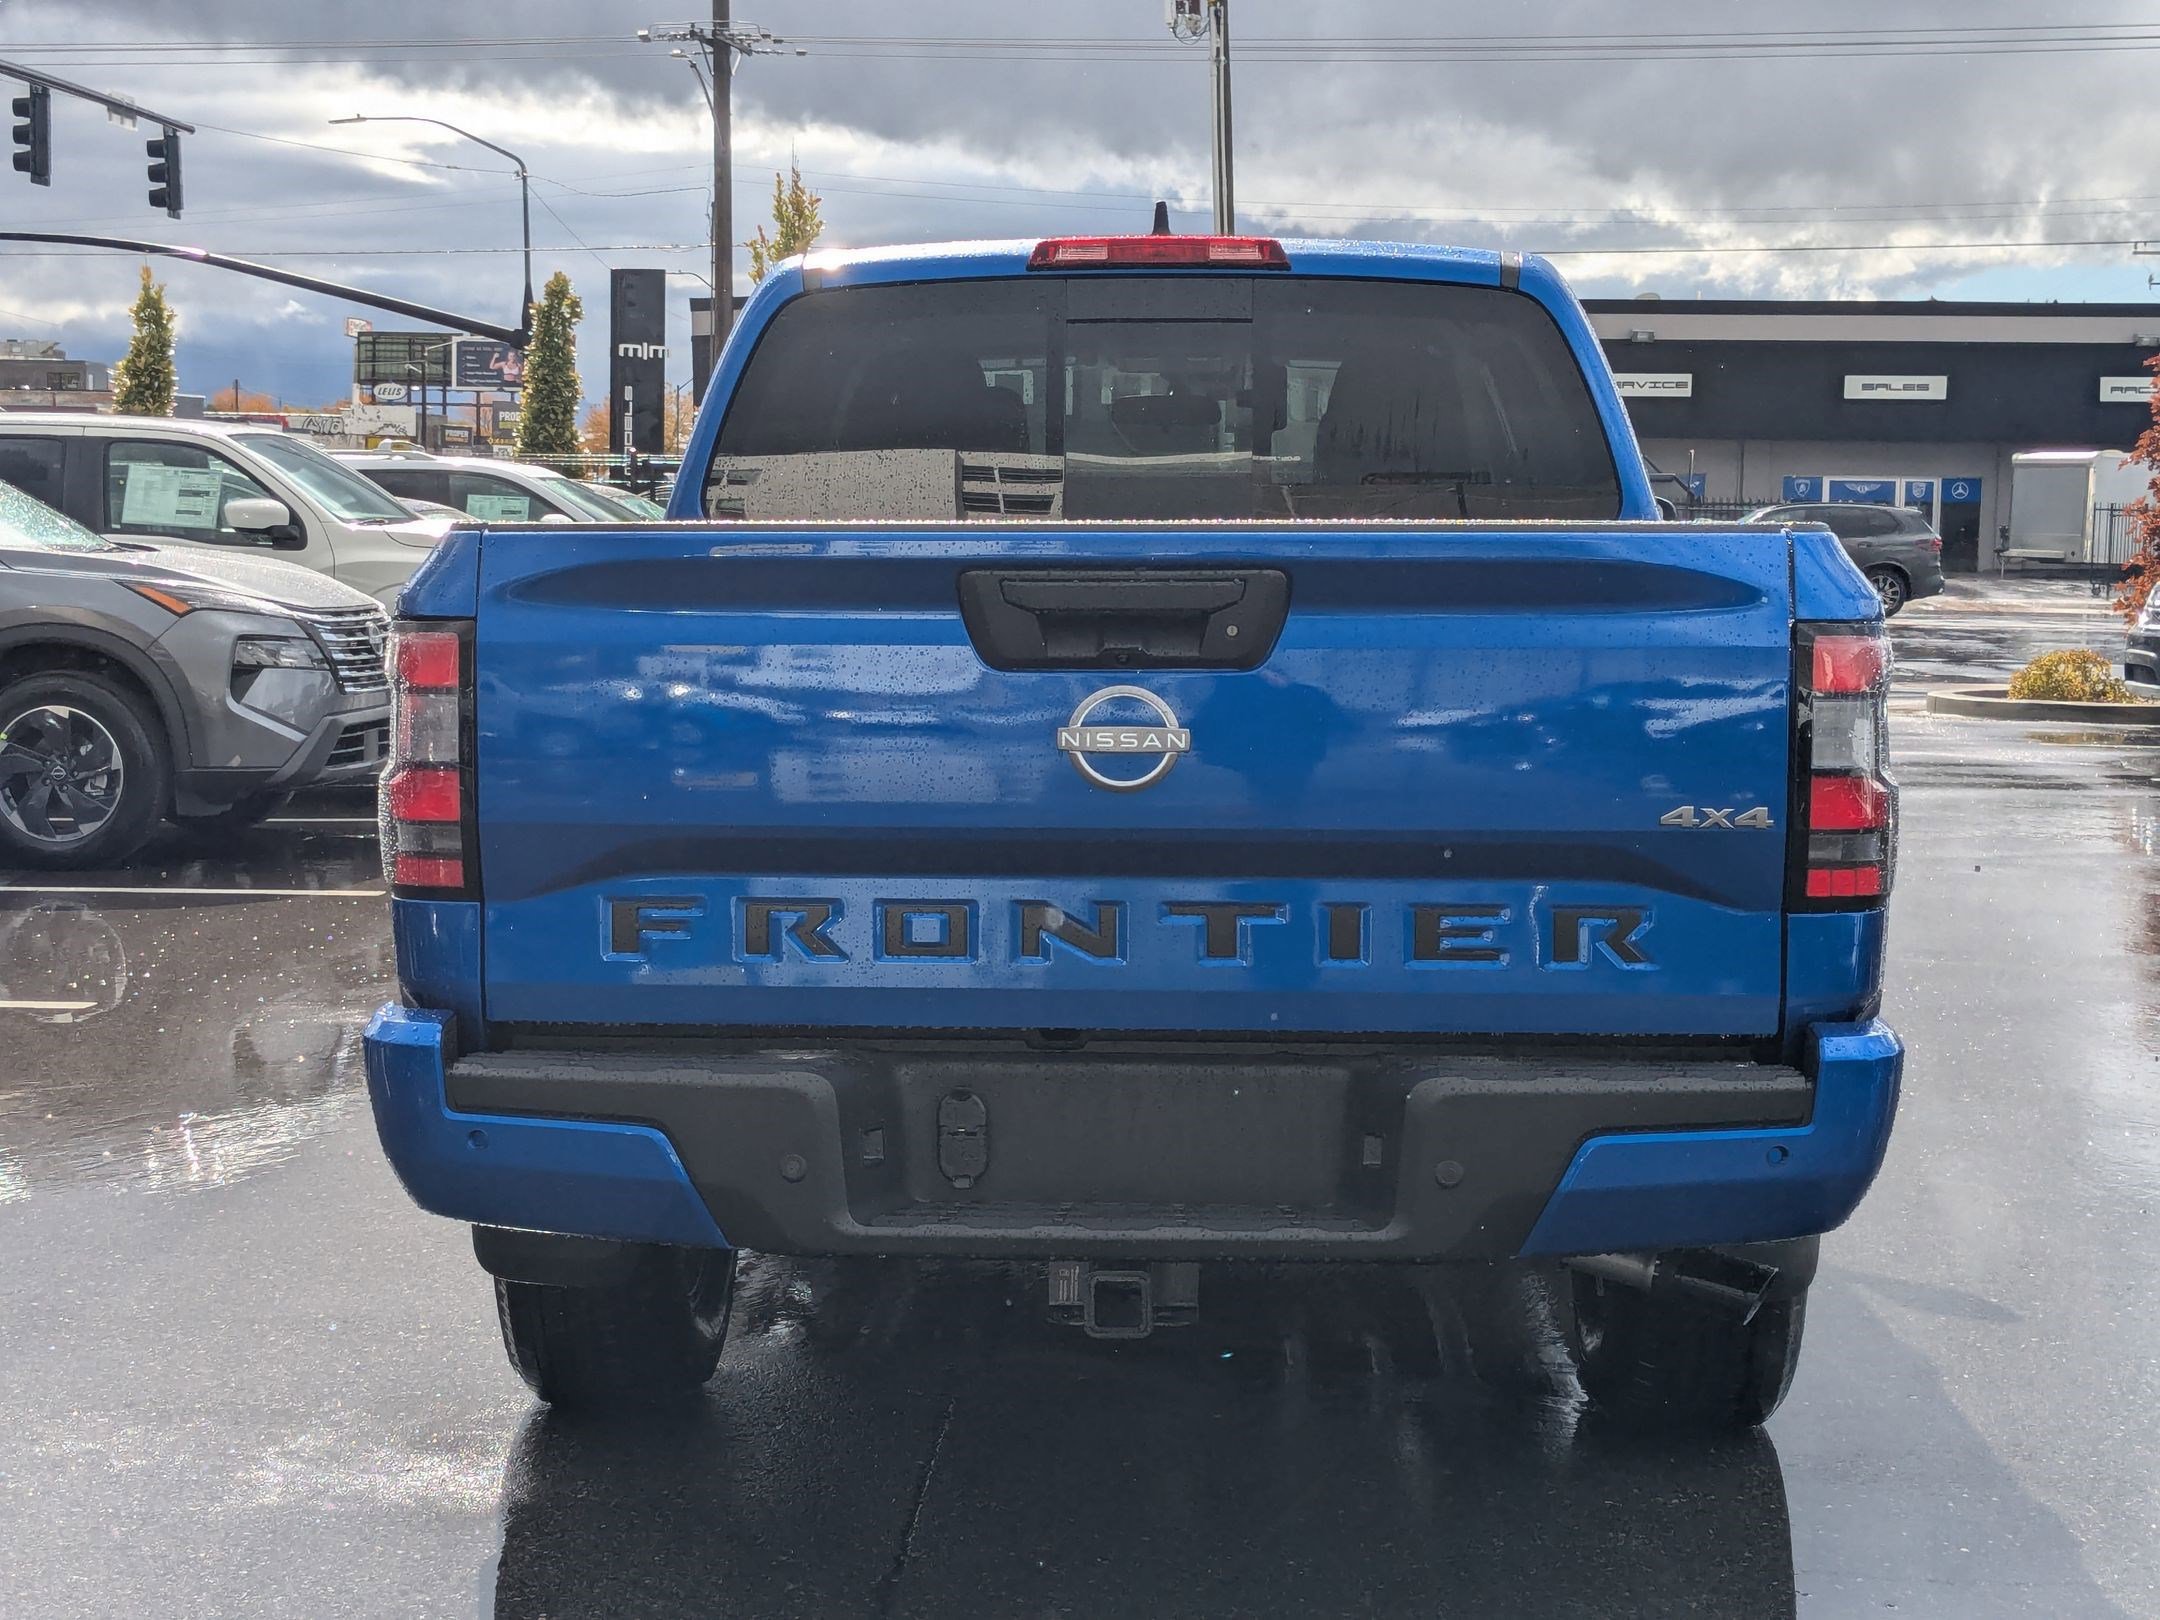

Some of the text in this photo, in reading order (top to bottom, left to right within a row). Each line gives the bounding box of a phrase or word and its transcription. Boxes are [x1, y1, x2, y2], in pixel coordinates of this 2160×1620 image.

[377, 387, 402, 396] LELIS
[1861, 383, 1930, 392] SALES
[1061, 731, 1187, 749] NISSAN
[605, 896, 1652, 968] FRONTIER
